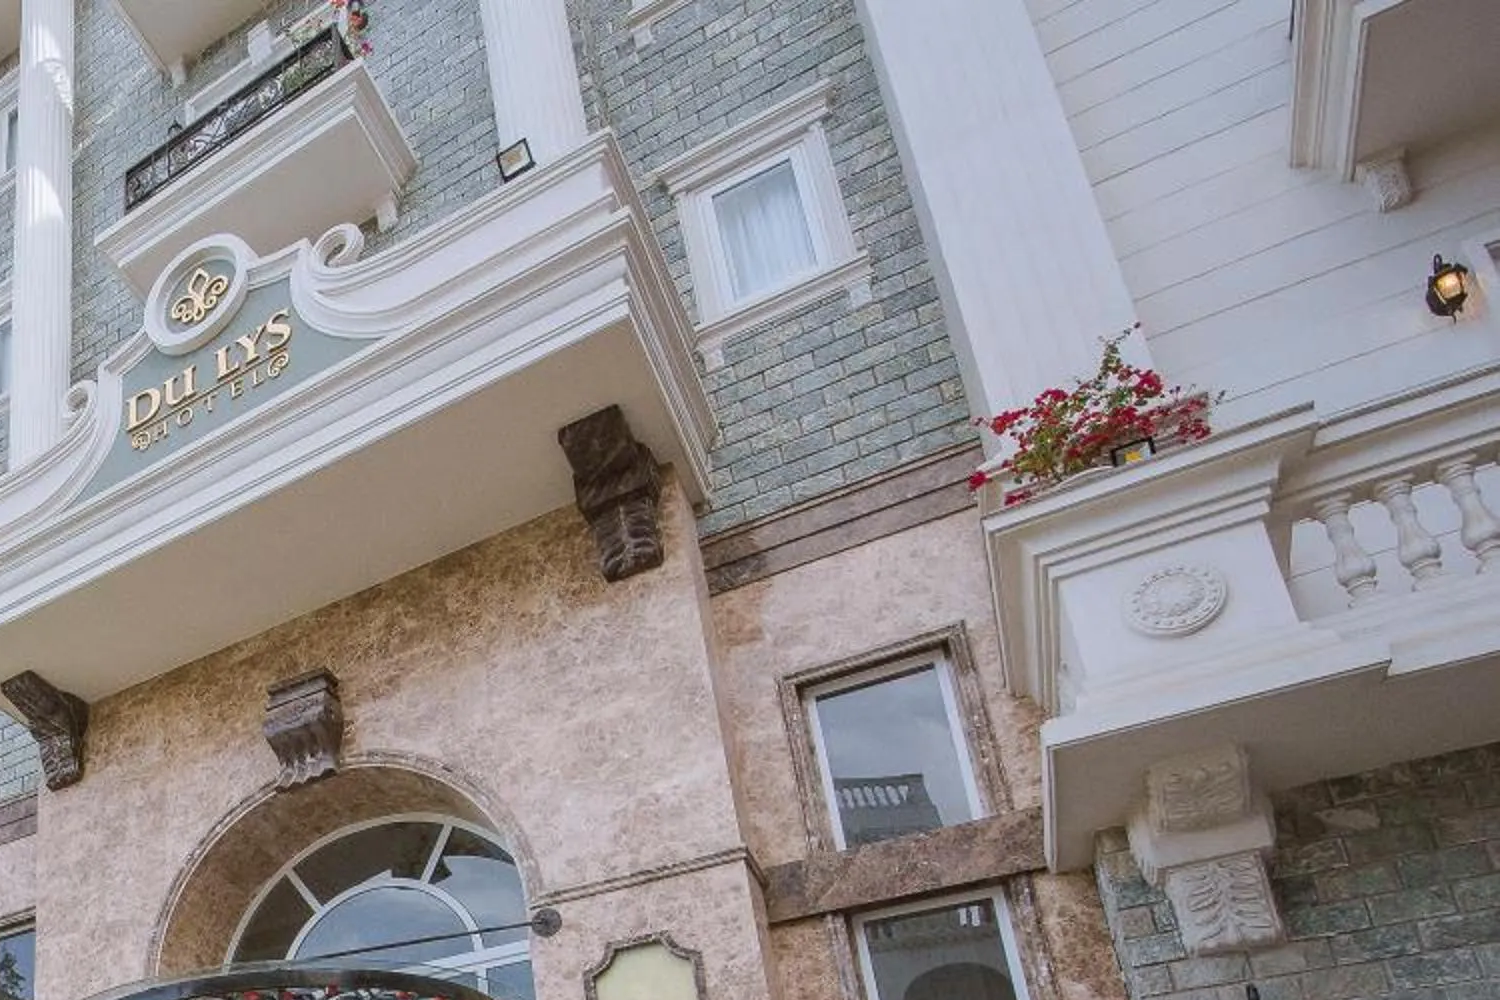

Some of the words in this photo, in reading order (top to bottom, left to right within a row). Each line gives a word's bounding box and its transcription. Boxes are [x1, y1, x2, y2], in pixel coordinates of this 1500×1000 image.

[126, 365, 197, 433] DU
[215, 308, 293, 382] LYS
[152, 369, 265, 444] HOTEL
